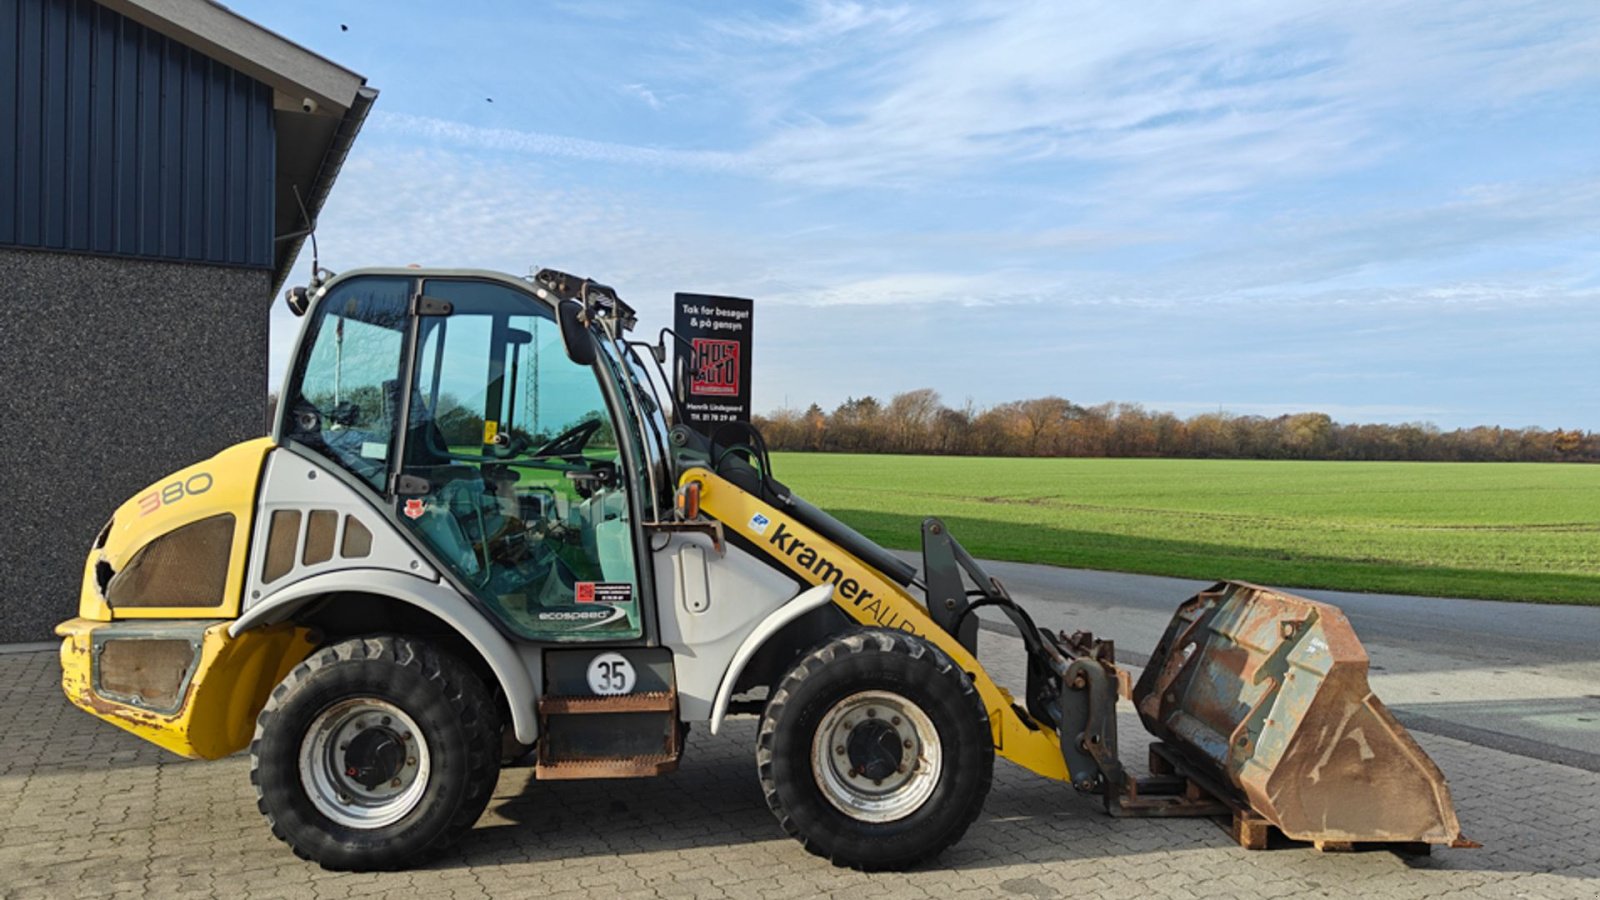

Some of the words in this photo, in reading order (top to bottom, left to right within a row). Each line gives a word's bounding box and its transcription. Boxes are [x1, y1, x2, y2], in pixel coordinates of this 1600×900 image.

[683, 304, 699, 314] Tak
[700, 305, 714, 316] for
[690, 317, 698, 327] &
[699, 319, 712, 329] på
[698, 343, 734, 368] HOLT
[138, 472, 213, 517] 380
[769, 523, 873, 606] kramer
[598, 661, 626, 690] 35
